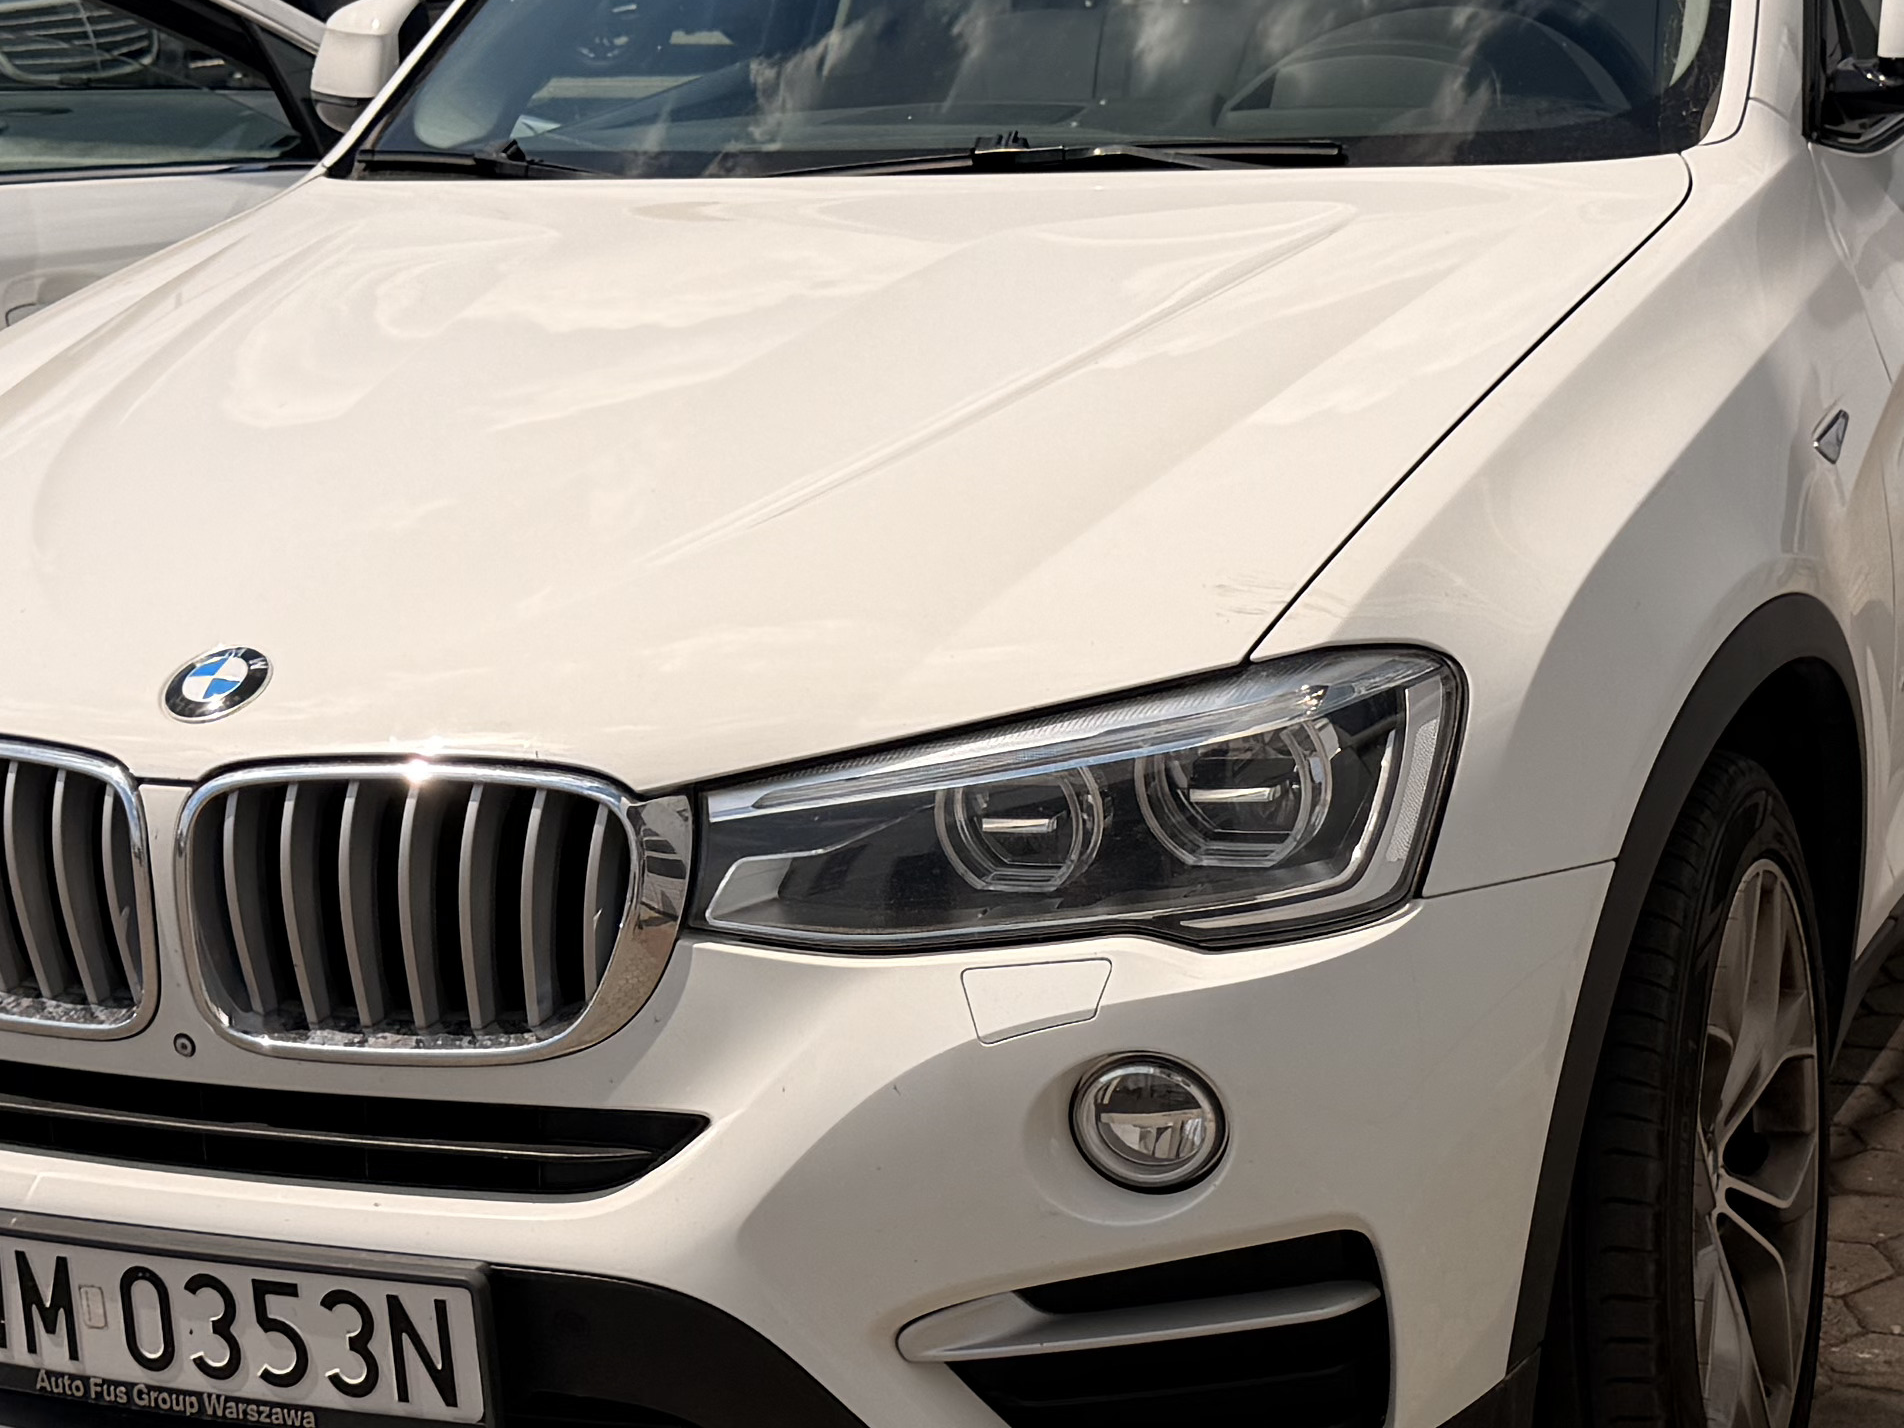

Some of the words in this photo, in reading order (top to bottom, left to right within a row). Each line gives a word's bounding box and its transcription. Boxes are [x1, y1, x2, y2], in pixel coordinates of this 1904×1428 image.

[119, 1265, 458, 1408] 0353N
[36, 1369, 85, 1398] Auto
[90, 1376, 128, 1404] Fus
[132, 1383, 198, 1417] Group
